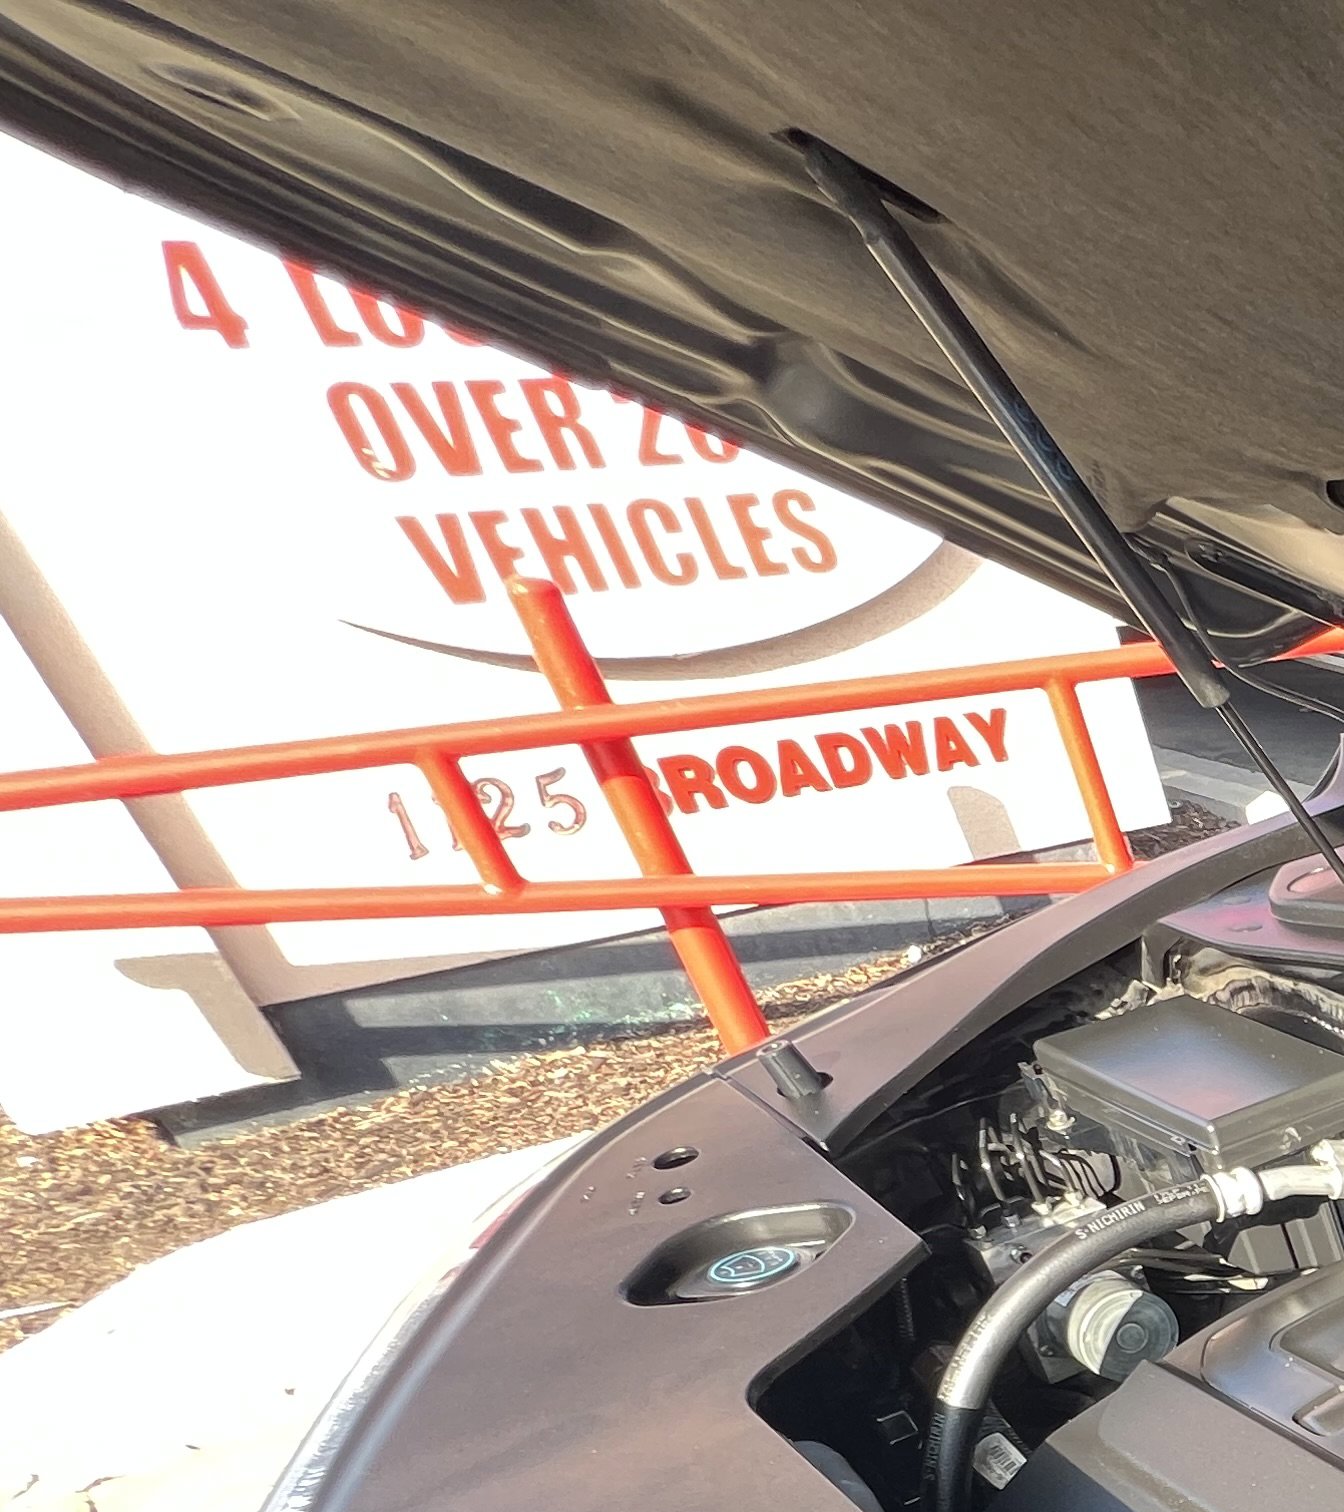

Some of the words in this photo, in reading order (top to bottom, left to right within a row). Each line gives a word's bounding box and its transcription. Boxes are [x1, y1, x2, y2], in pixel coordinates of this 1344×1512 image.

[161, 240, 250, 349] 4
[282, 258, 486, 348] LO
[326, 373, 606, 482] OVER
[611, 387, 741, 466] 2
[395, 489, 838, 605] VEHICLES
[388, 767, 587, 861] 125
[643, 708, 1009, 818] ROADWAY
